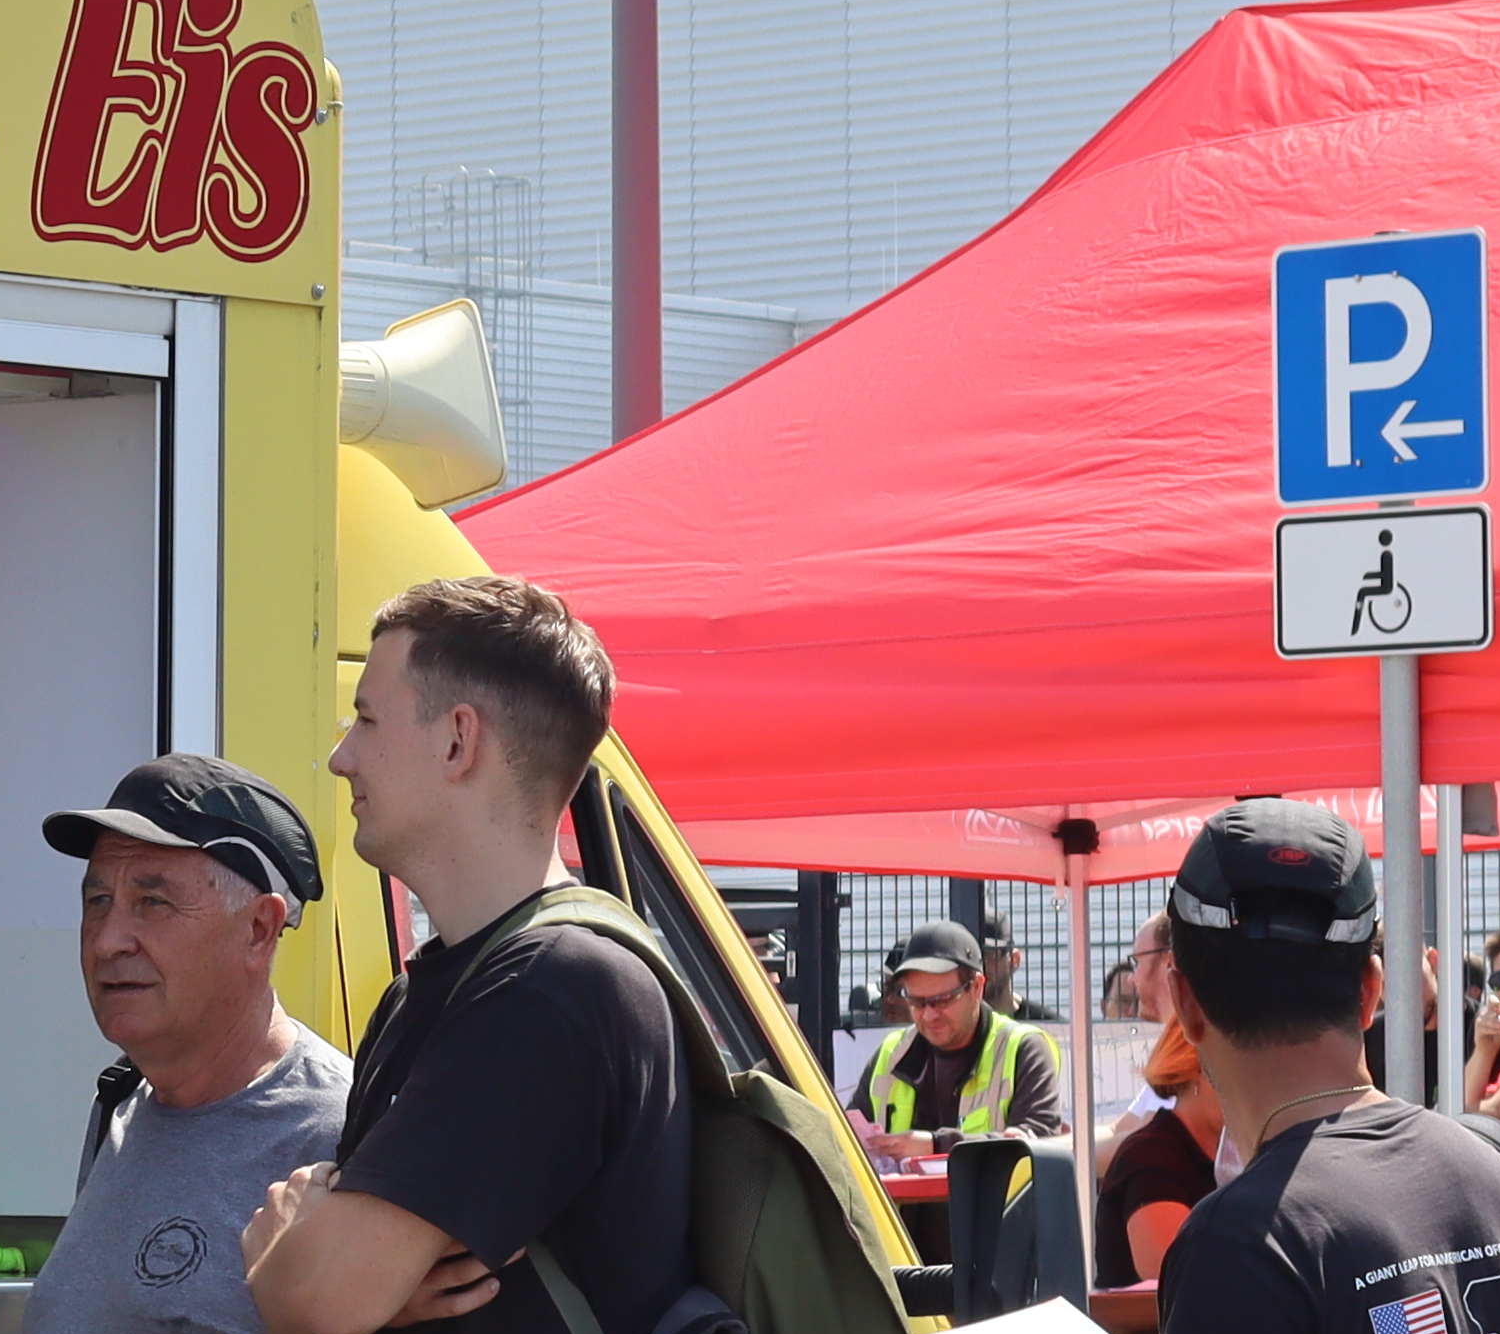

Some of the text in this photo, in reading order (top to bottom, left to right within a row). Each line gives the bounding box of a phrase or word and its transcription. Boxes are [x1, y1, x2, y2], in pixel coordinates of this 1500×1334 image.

[1324, 273, 1433, 467] P
[1354, 1277, 1366, 1291] A
[1365, 1263, 1398, 1286] GIANT
[1397, 1256, 1417, 1275] LEAP
